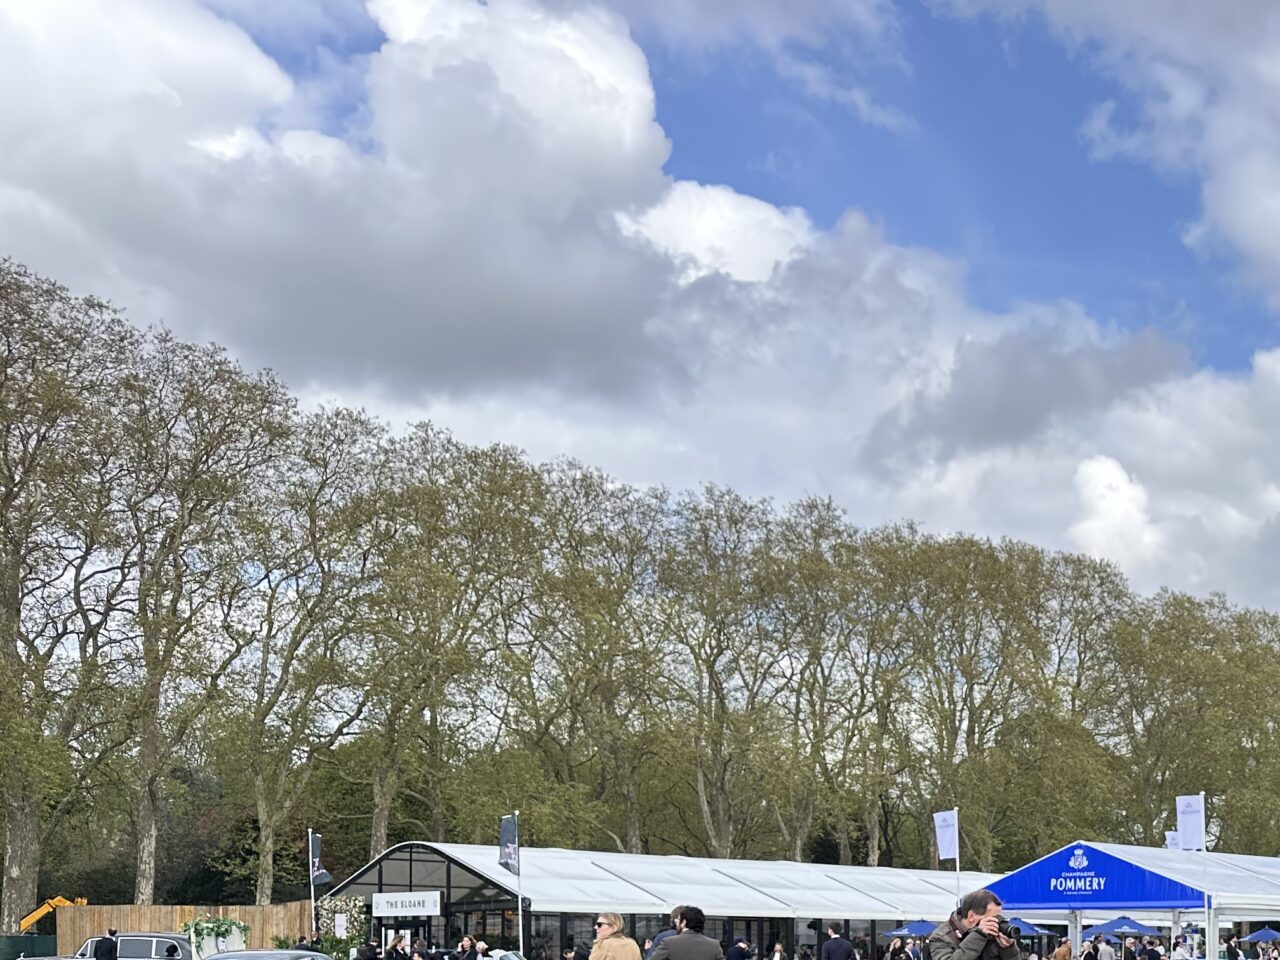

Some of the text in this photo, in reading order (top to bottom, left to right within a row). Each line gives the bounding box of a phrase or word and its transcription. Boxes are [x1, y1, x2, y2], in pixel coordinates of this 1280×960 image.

[1050, 877, 1106, 891] POMMERY
[386, 899, 426, 909] THE SLOANE
